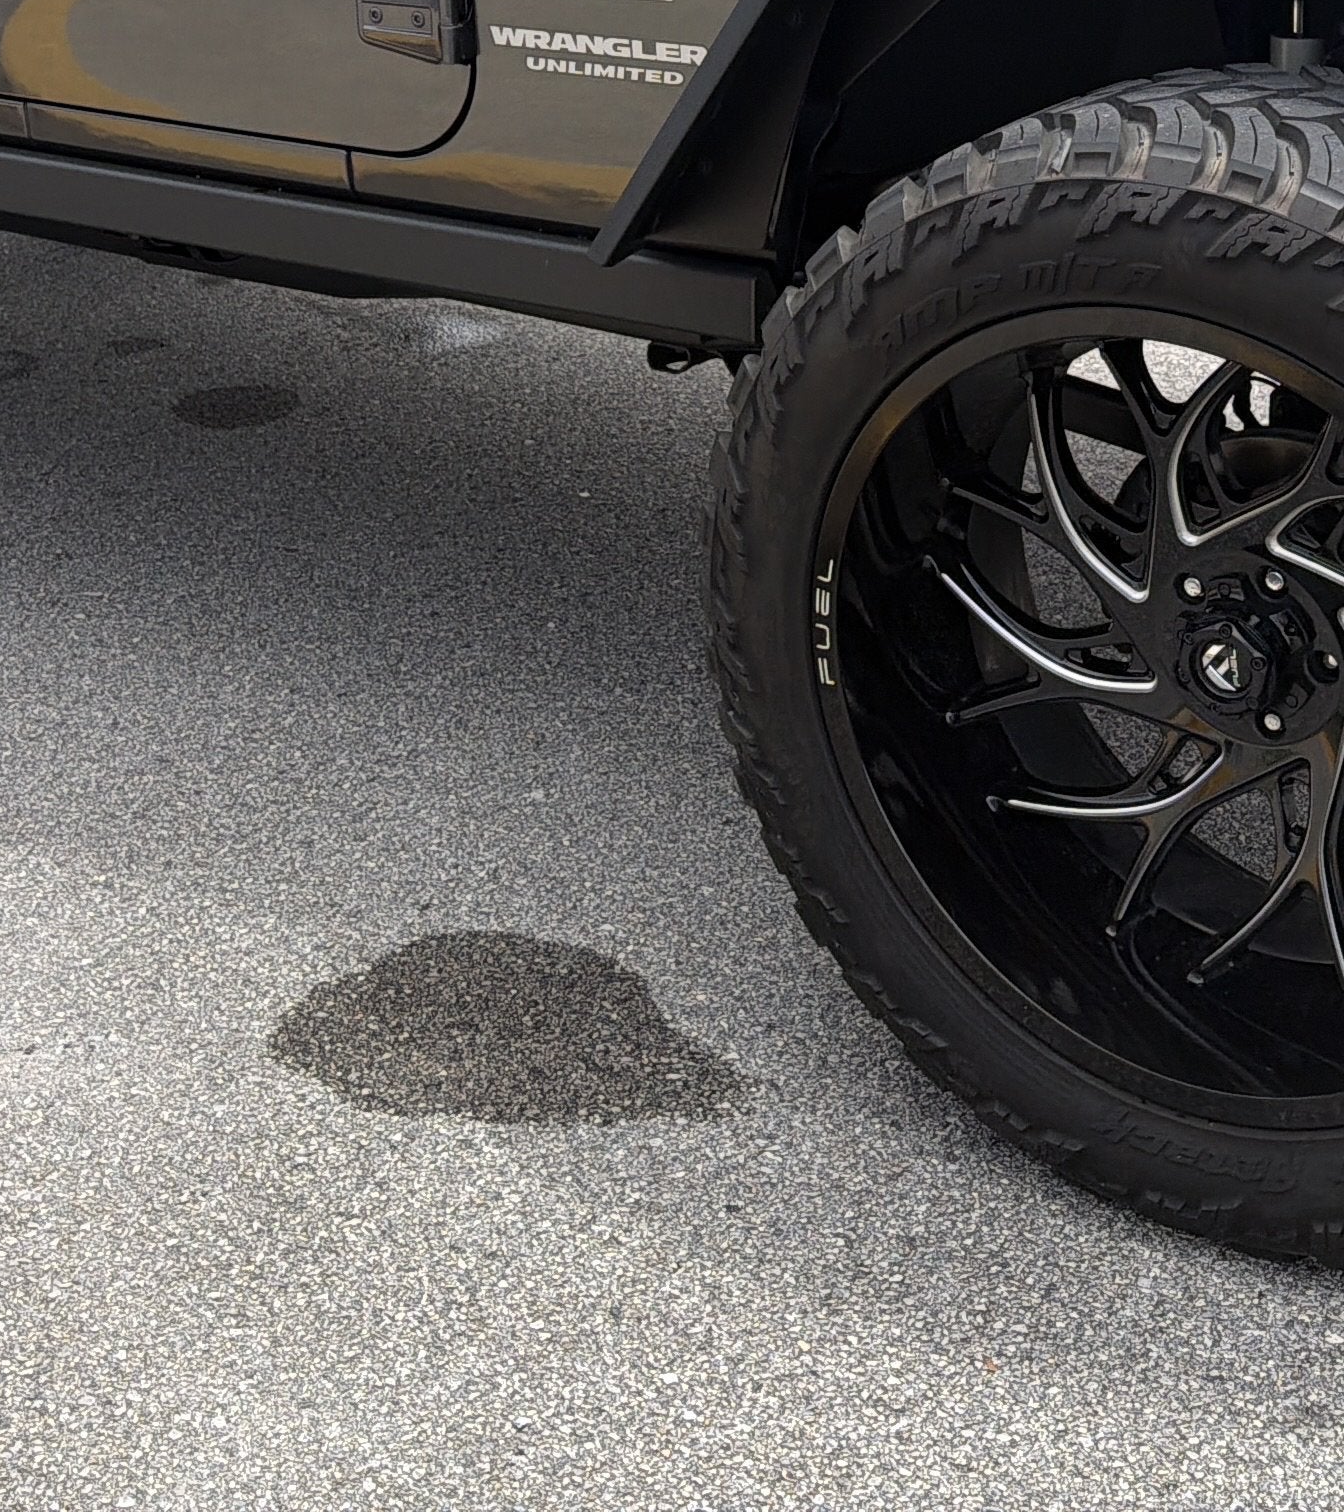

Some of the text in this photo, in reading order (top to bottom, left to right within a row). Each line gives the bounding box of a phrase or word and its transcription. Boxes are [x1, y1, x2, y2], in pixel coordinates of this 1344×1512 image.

[489, 25, 708, 67] WRANGLER
[526, 56, 684, 86] UNLIMITED
[814, 558, 836, 686] FUEL
